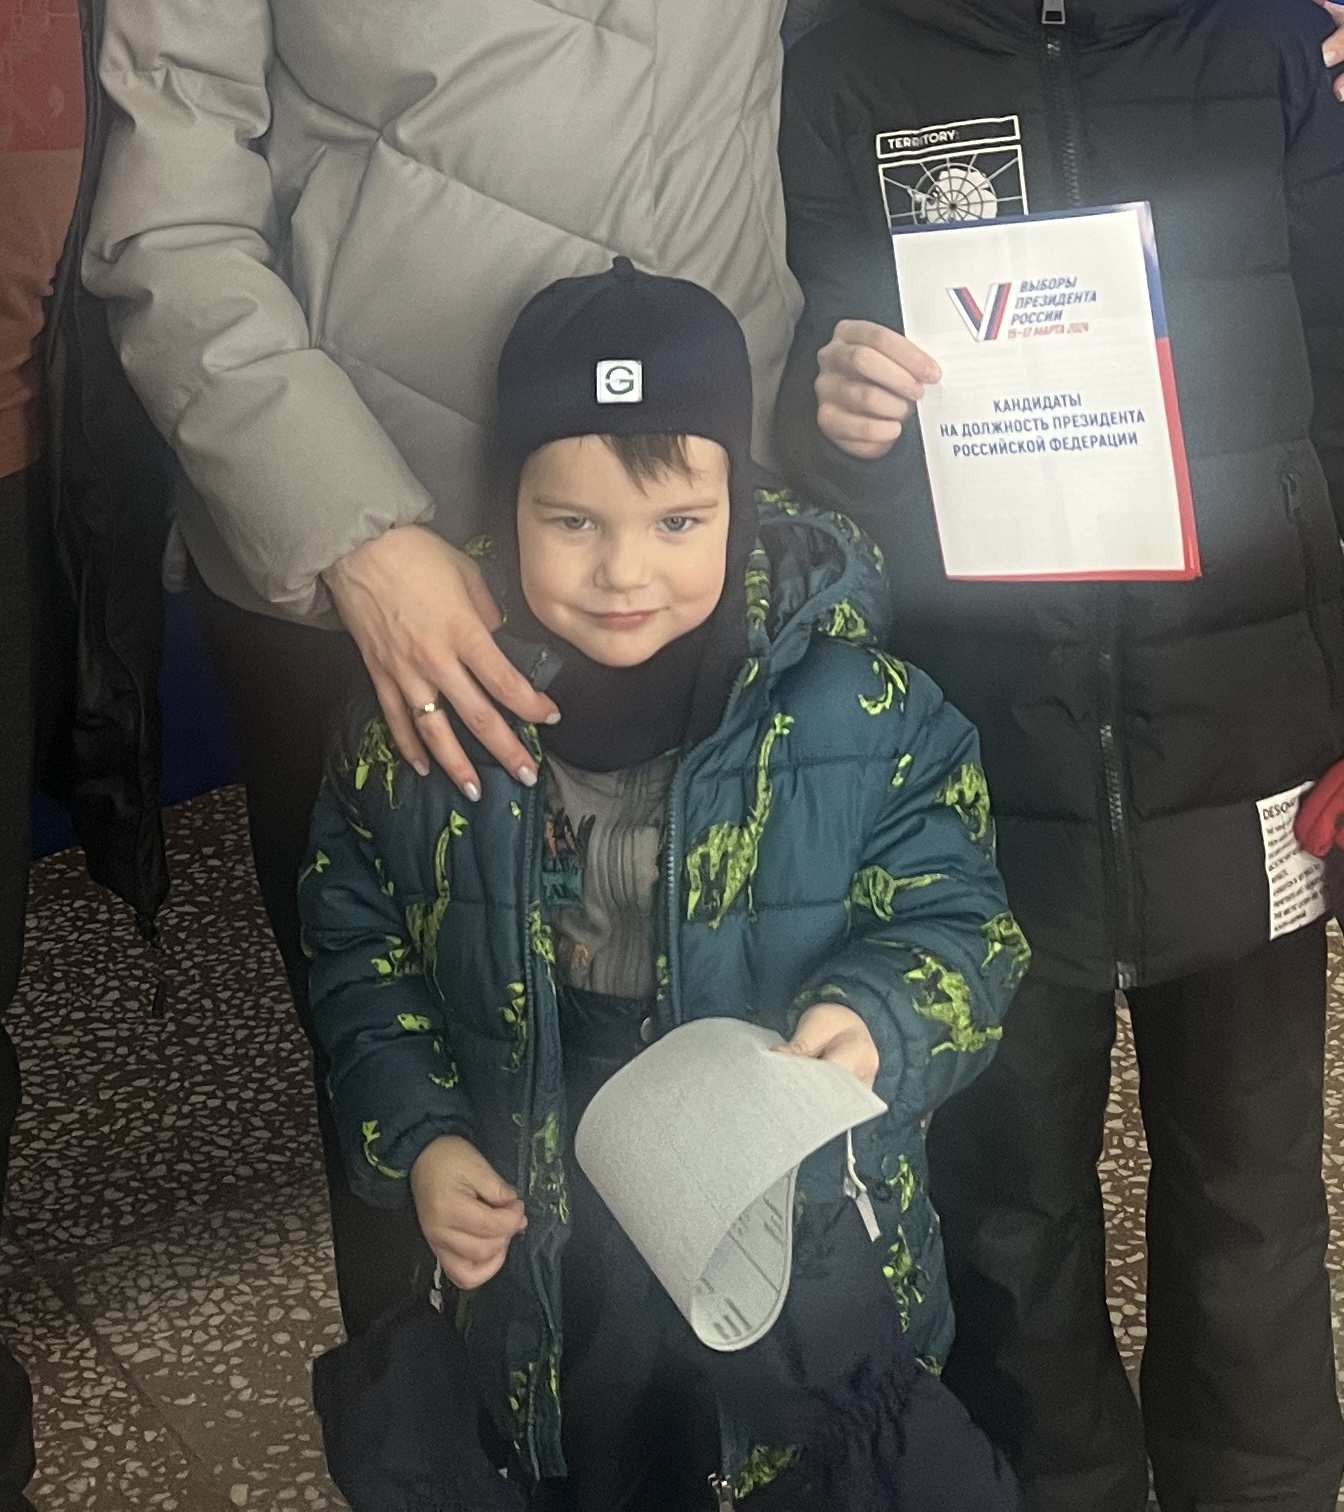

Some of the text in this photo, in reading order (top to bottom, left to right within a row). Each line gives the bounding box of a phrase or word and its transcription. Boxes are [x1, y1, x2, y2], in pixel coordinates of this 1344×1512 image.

[1019, 276, 1078, 293] ВЫБОРЫ
[1014, 290, 1097, 309] ПРЕЗИДЕНТА
[1010, 309, 1064, 325] РОССИИ
[993, 393, 1082, 413] КАНДИДАТЫ
[940, 409, 1146, 438] НА ДОЛЖНОСТЬ ПРЕЗИДЕНТА
[953, 432, 1138, 457] РОССИЙСКОЙ ФЕДЕРАЦИИ
